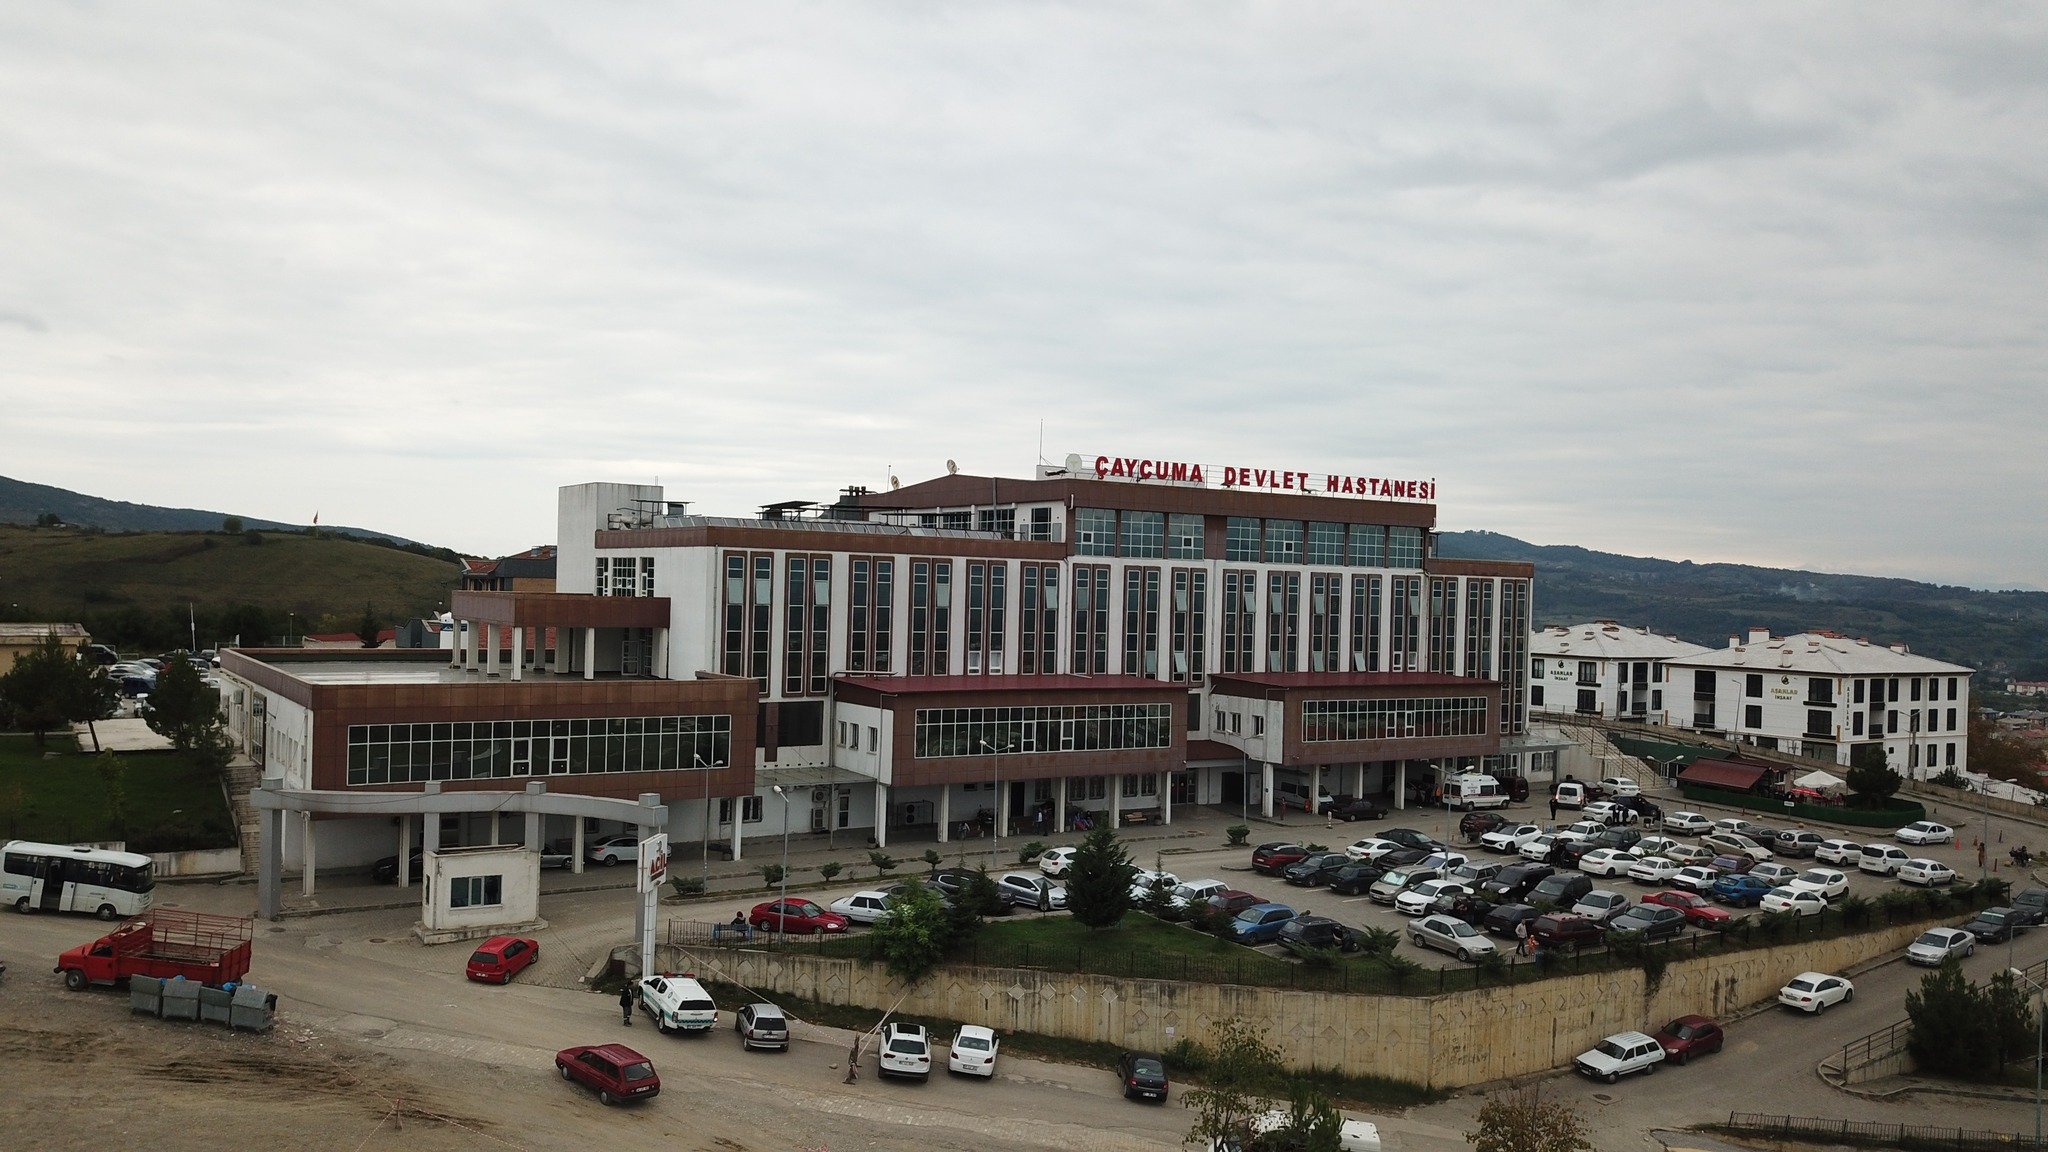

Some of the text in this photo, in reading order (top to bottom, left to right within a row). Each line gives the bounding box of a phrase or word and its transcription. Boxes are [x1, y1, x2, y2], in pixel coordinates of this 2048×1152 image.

[1095, 456, 1435, 499] ÇAYCUMA DEVLET HASTANESİ
